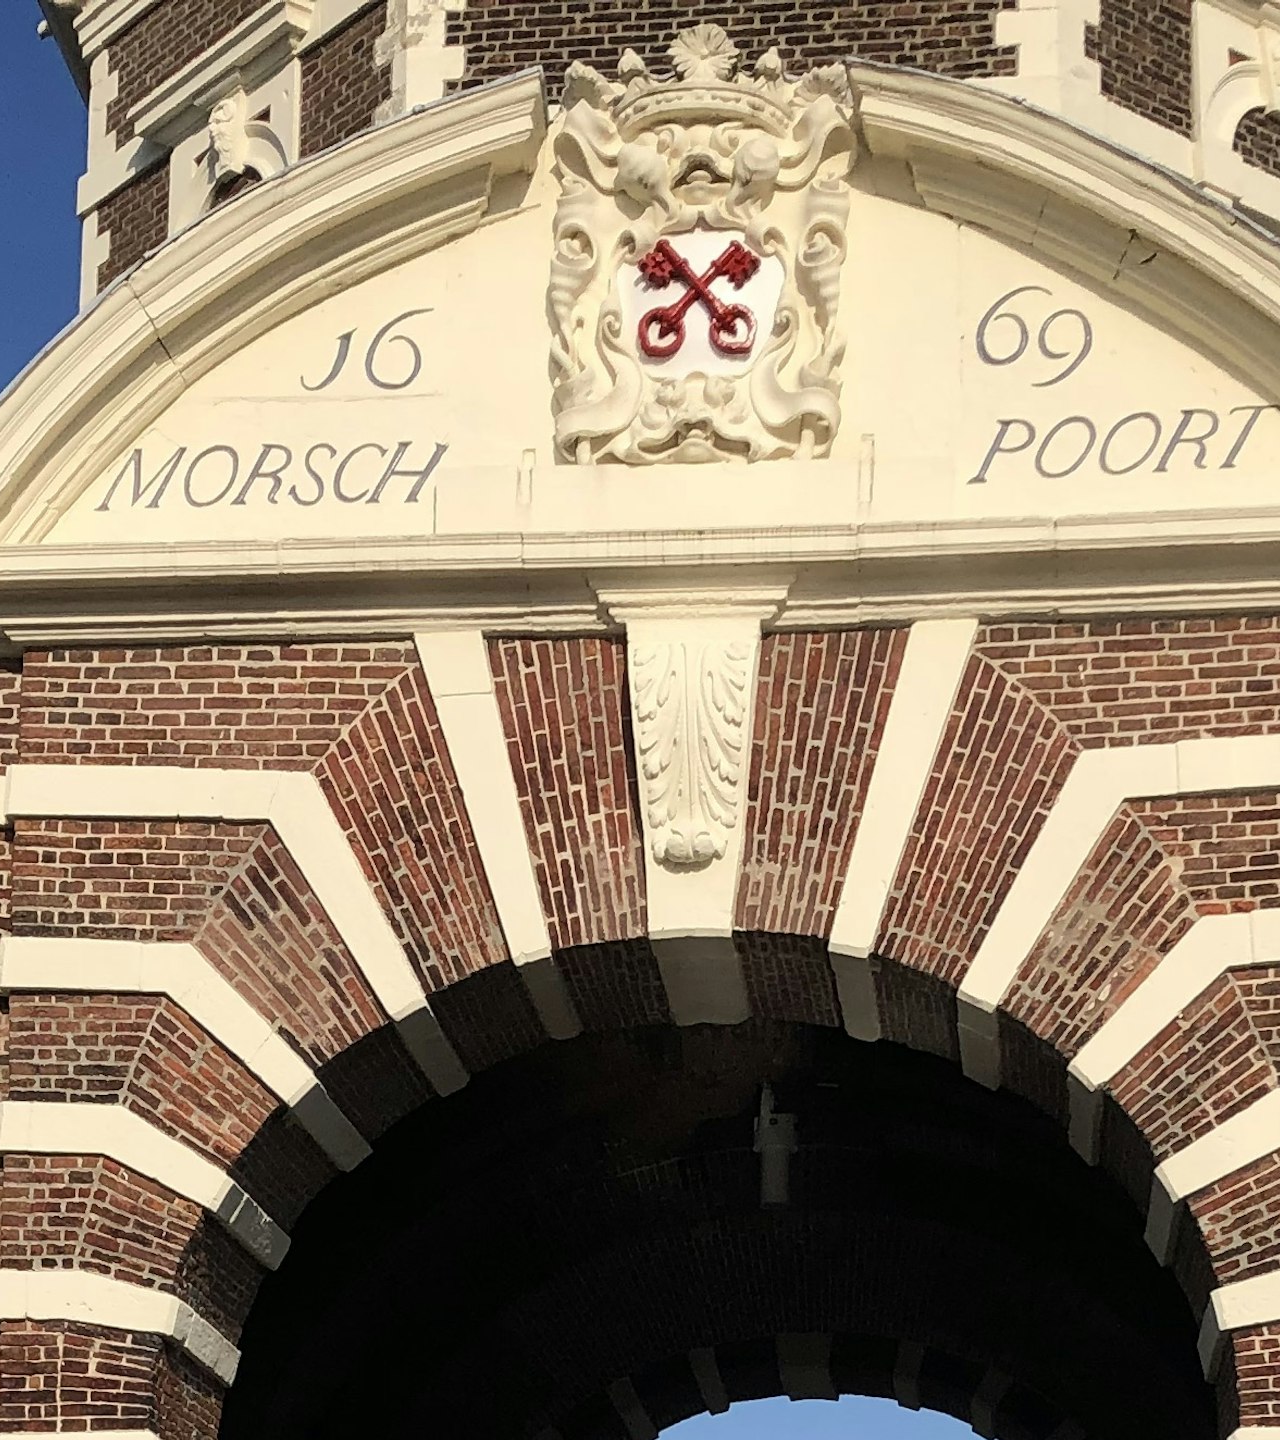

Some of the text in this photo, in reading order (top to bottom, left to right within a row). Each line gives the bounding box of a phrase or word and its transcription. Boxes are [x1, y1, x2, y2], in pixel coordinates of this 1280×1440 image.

[300, 307, 435, 392] 16
[975, 285, 1094, 388] 69
[93, 440, 450, 512] MORSCH
